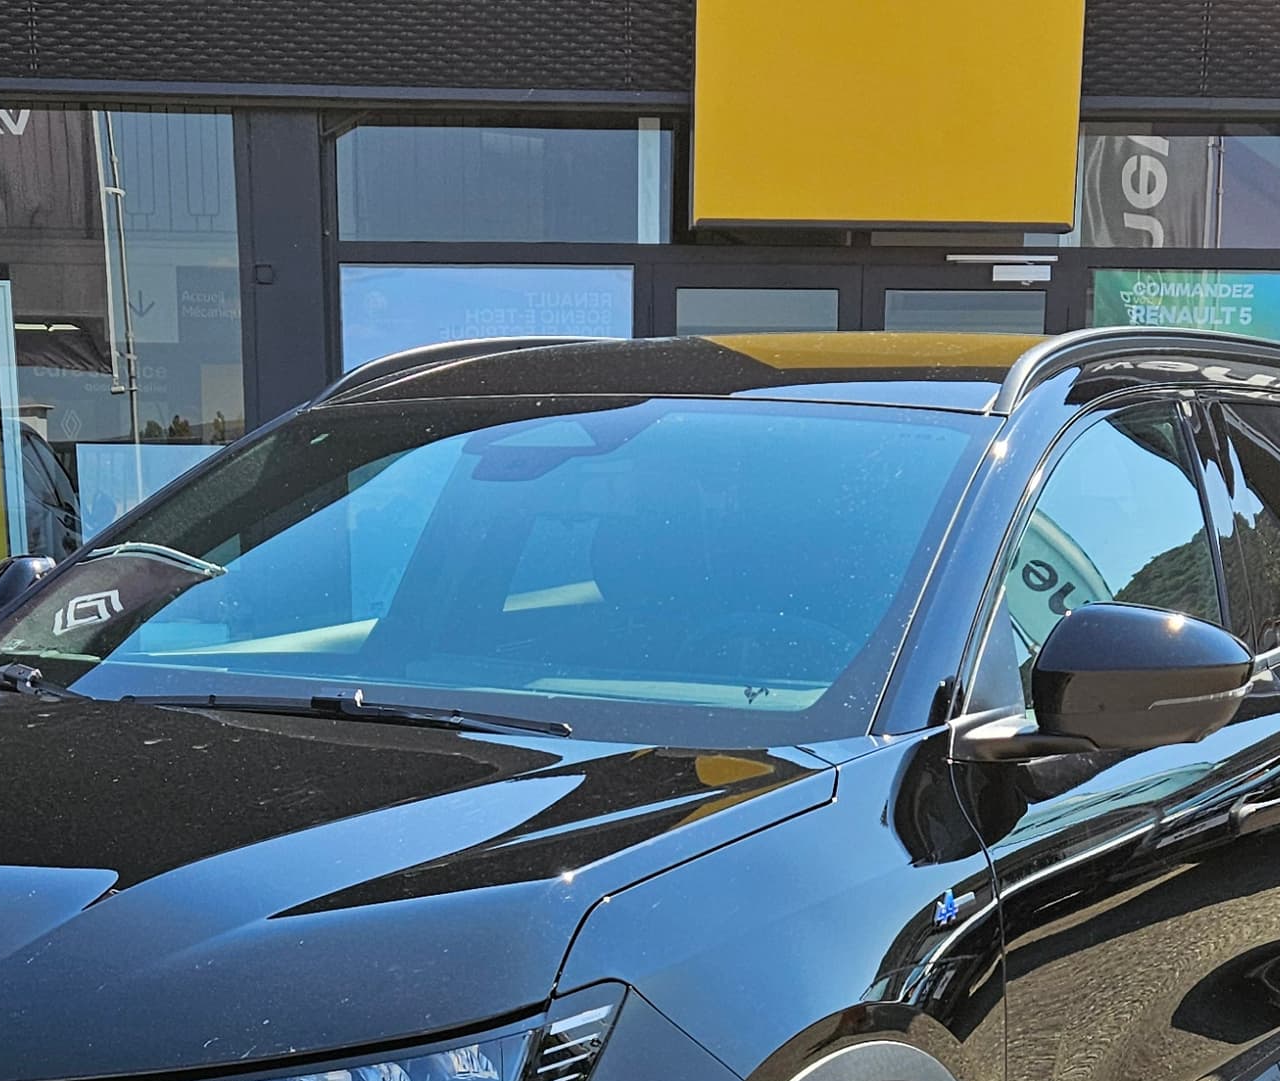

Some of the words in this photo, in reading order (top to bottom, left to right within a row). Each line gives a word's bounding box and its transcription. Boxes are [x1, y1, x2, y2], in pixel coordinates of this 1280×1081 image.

[181, 290, 224, 303] Accueil
[1132, 282, 1254, 298] COMMANDEZ
[1133, 306, 1236, 325] RENAULT
[1239, 307, 1252, 325] 5
